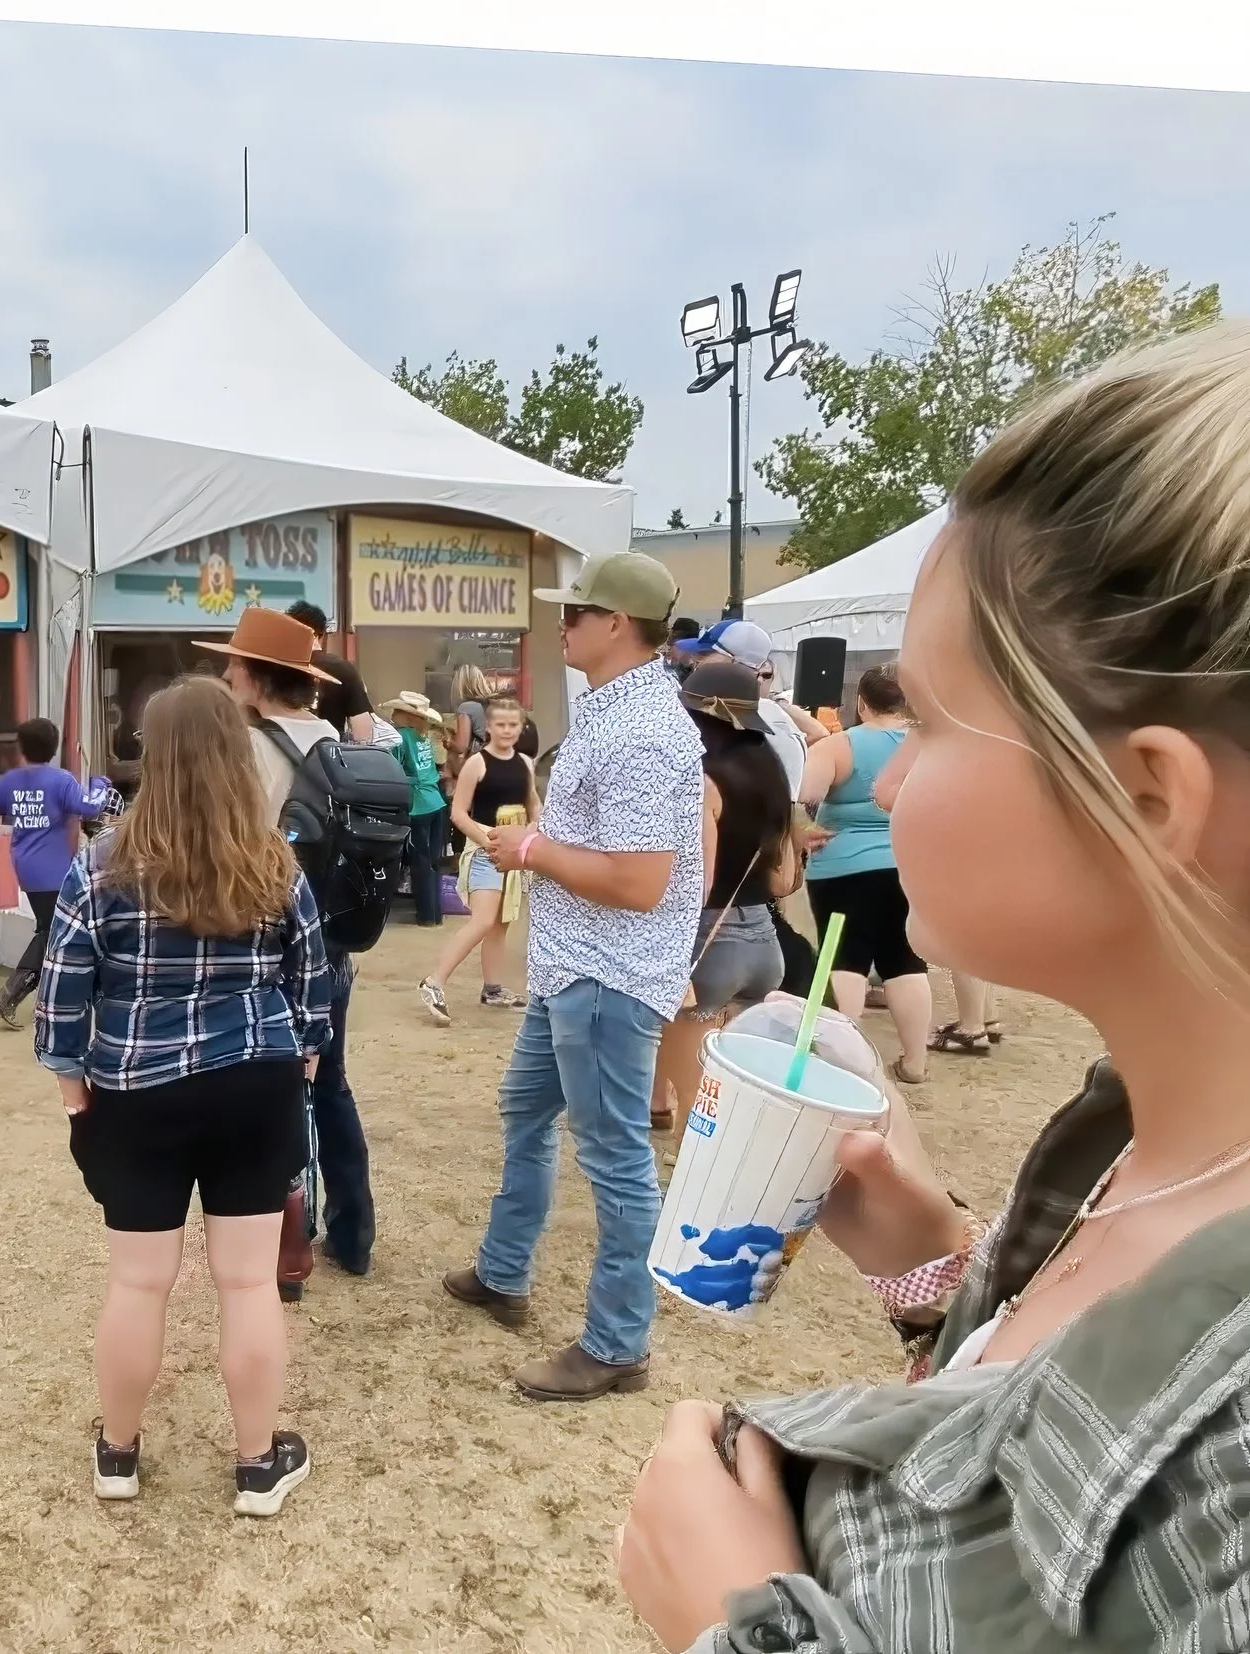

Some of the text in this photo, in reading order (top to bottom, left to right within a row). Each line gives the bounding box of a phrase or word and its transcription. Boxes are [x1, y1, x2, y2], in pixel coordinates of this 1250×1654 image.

[240, 522, 319, 572] TOSS
[369, 571, 516, 615] GAMES OF CHANCE
